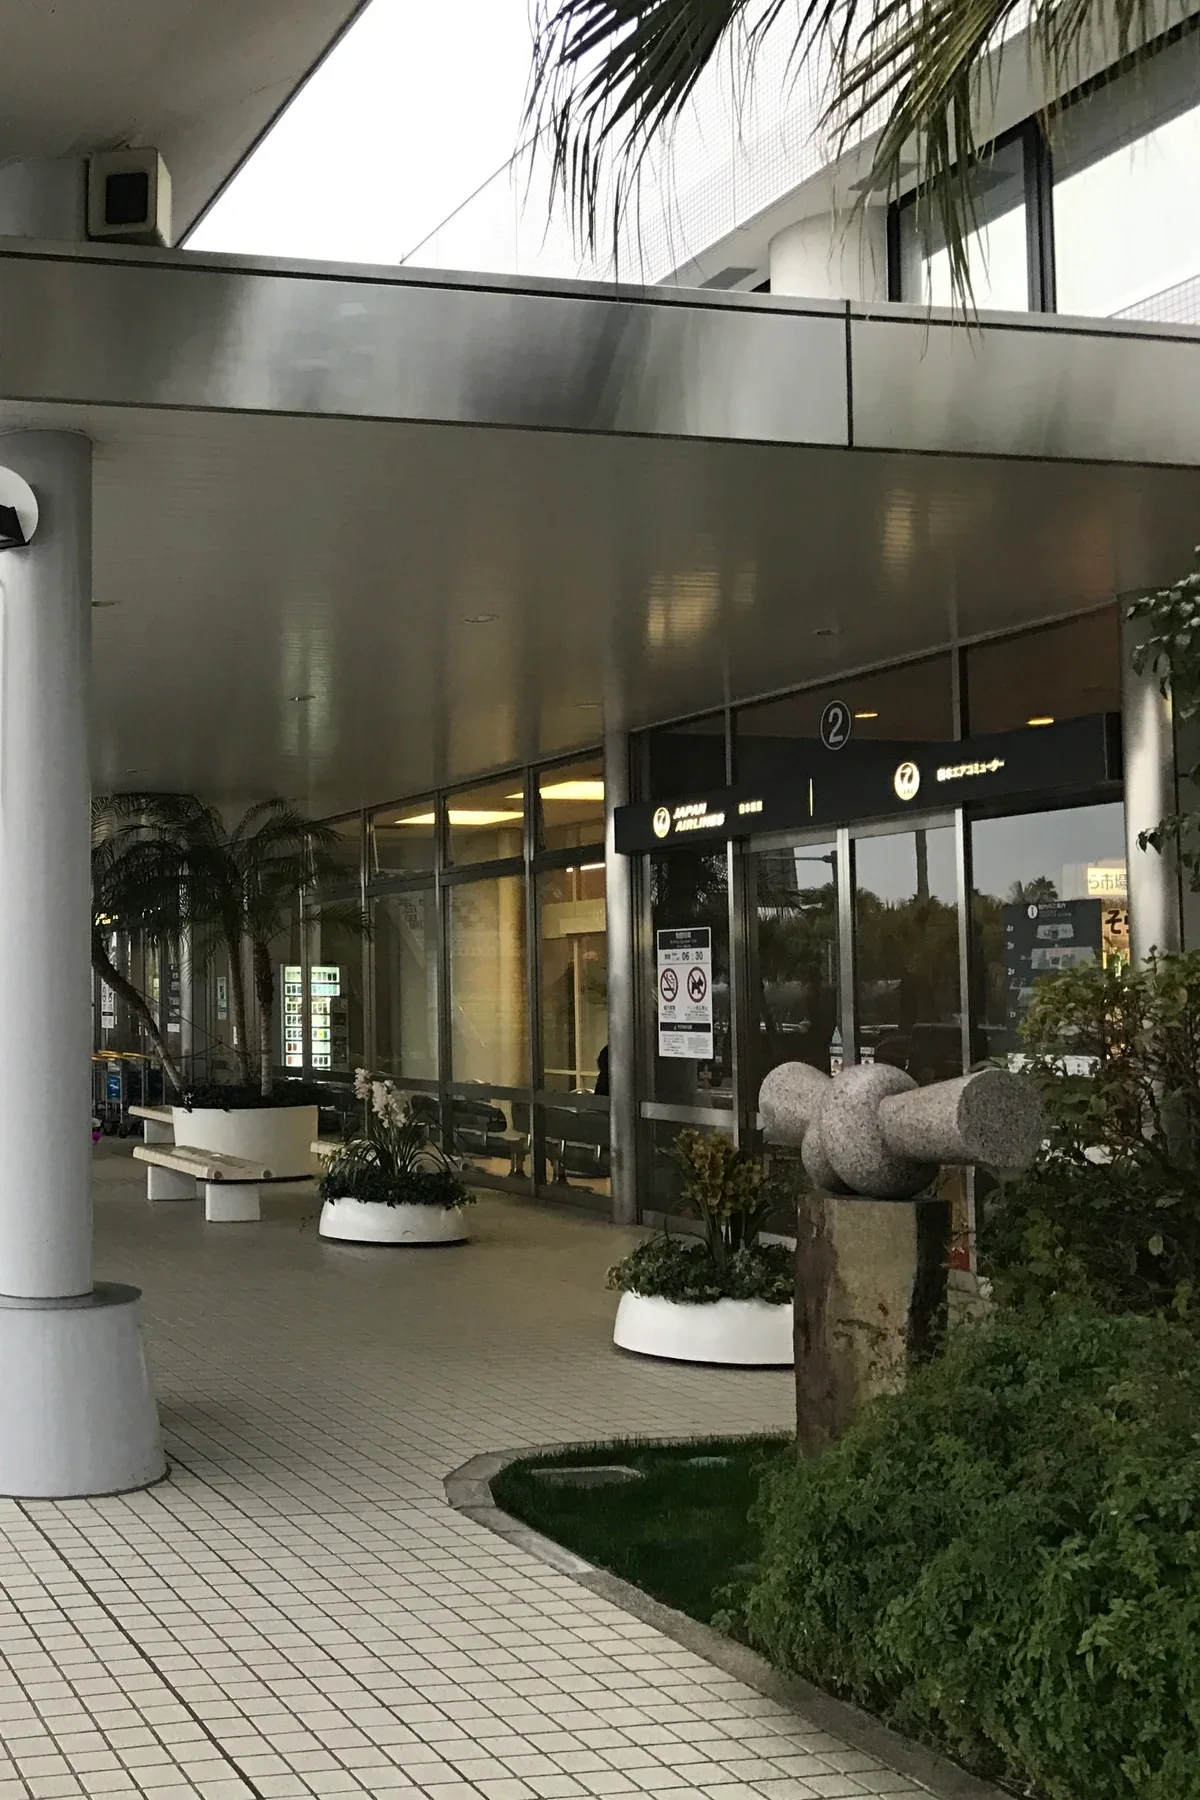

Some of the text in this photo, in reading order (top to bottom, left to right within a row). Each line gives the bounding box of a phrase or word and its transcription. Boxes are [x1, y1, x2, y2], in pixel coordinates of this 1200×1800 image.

[828, 707, 843, 743] 2
[673, 802, 707, 820] JAPAN
[674, 812, 725, 832] AIRLINES
